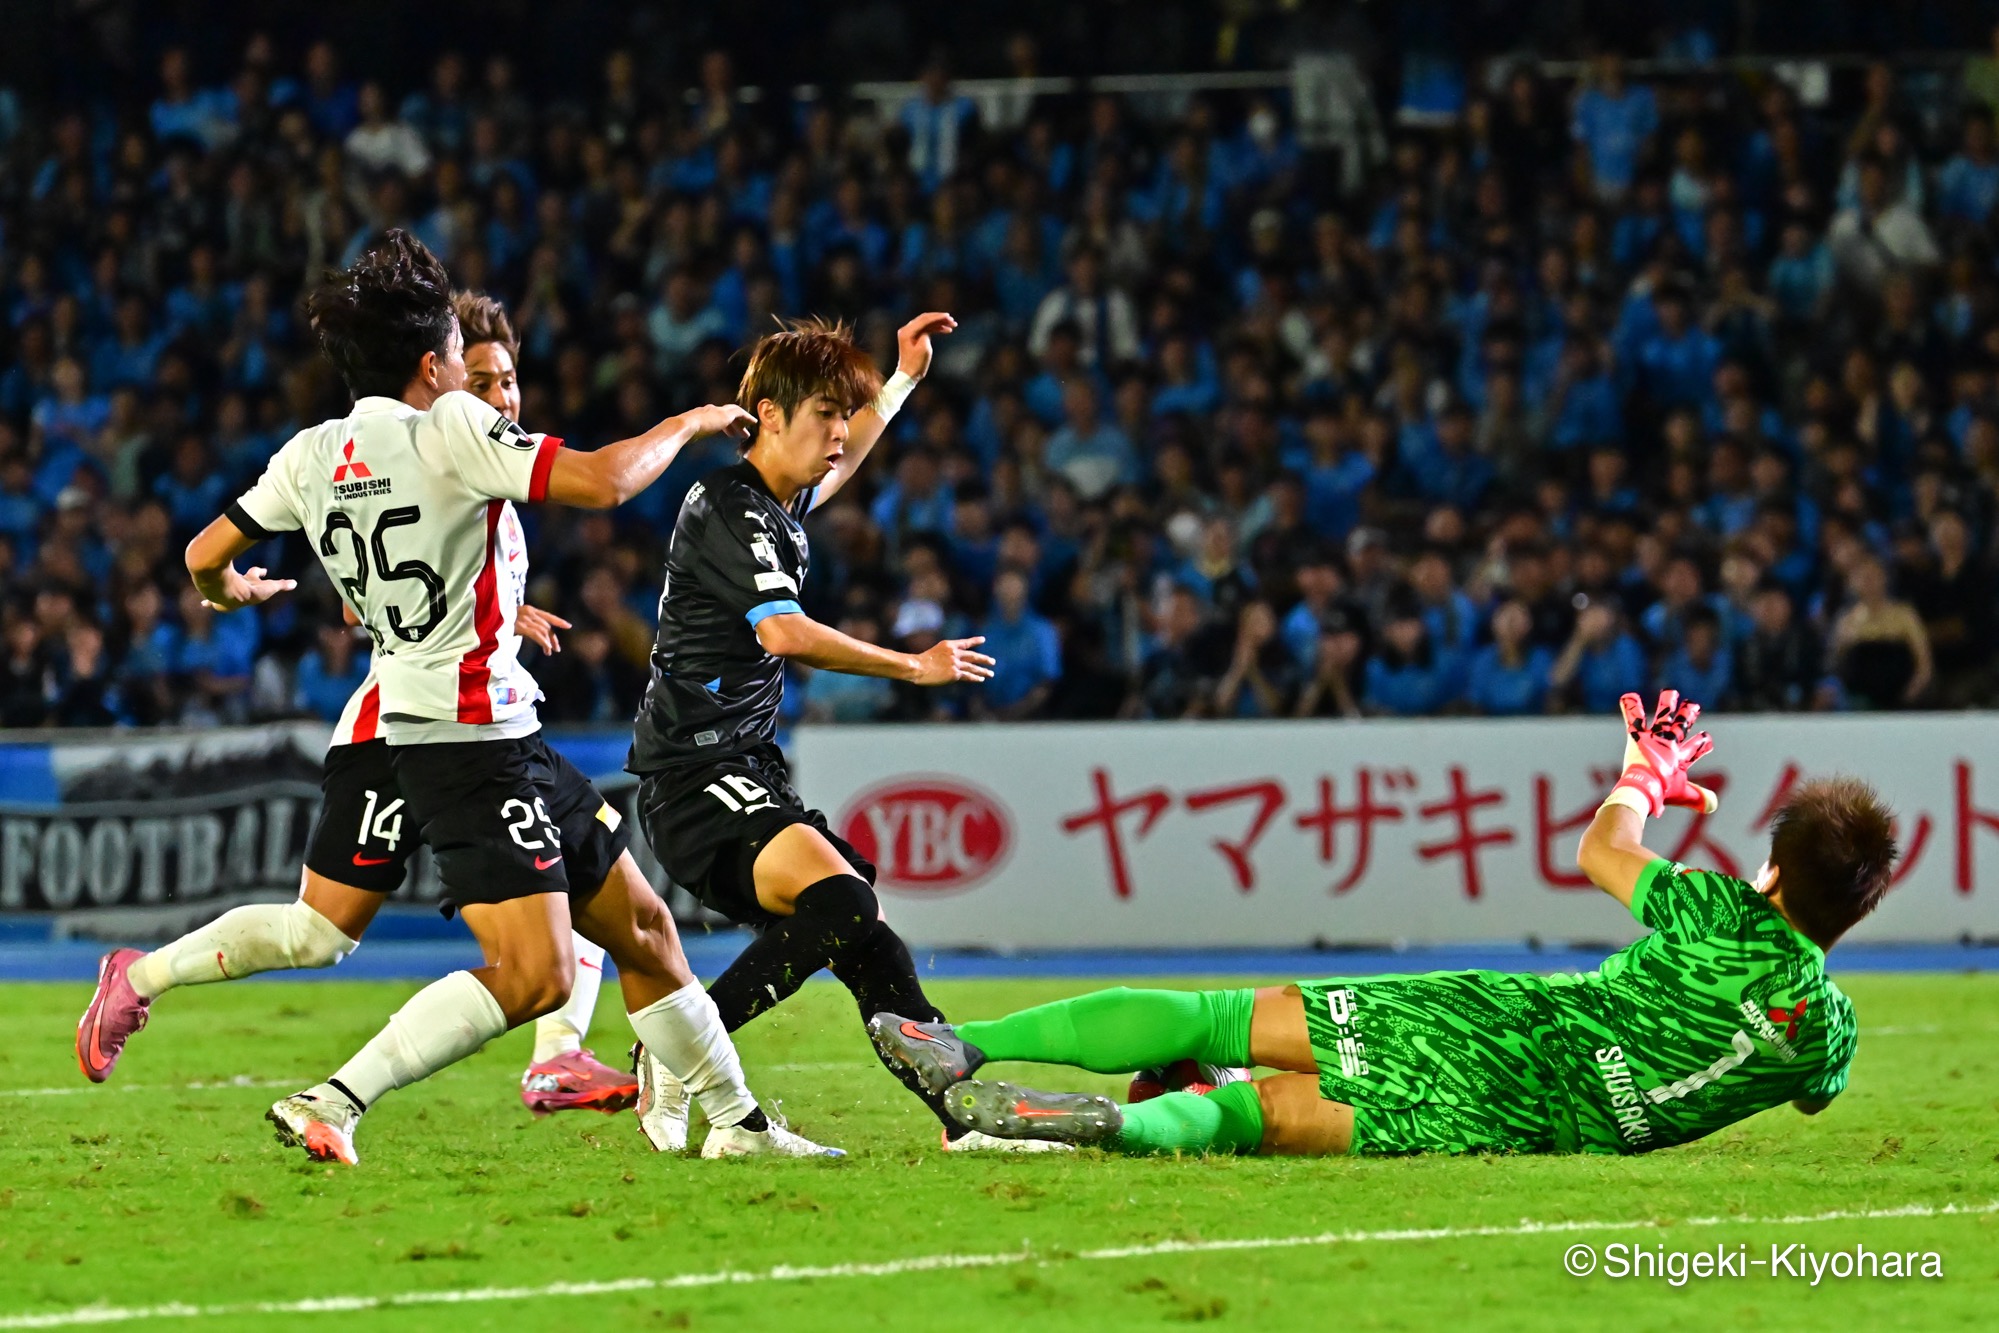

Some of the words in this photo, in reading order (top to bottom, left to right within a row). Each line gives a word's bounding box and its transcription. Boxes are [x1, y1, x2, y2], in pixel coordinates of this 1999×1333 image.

[344, 488, 392, 500] INDUSTRIES
[320, 504, 447, 649] 25
[357, 790, 405, 852] 14
[703, 774, 769, 812] 16
[868, 801, 987, 875] YBC
[1346, 989, 1369, 1075] DELICA
